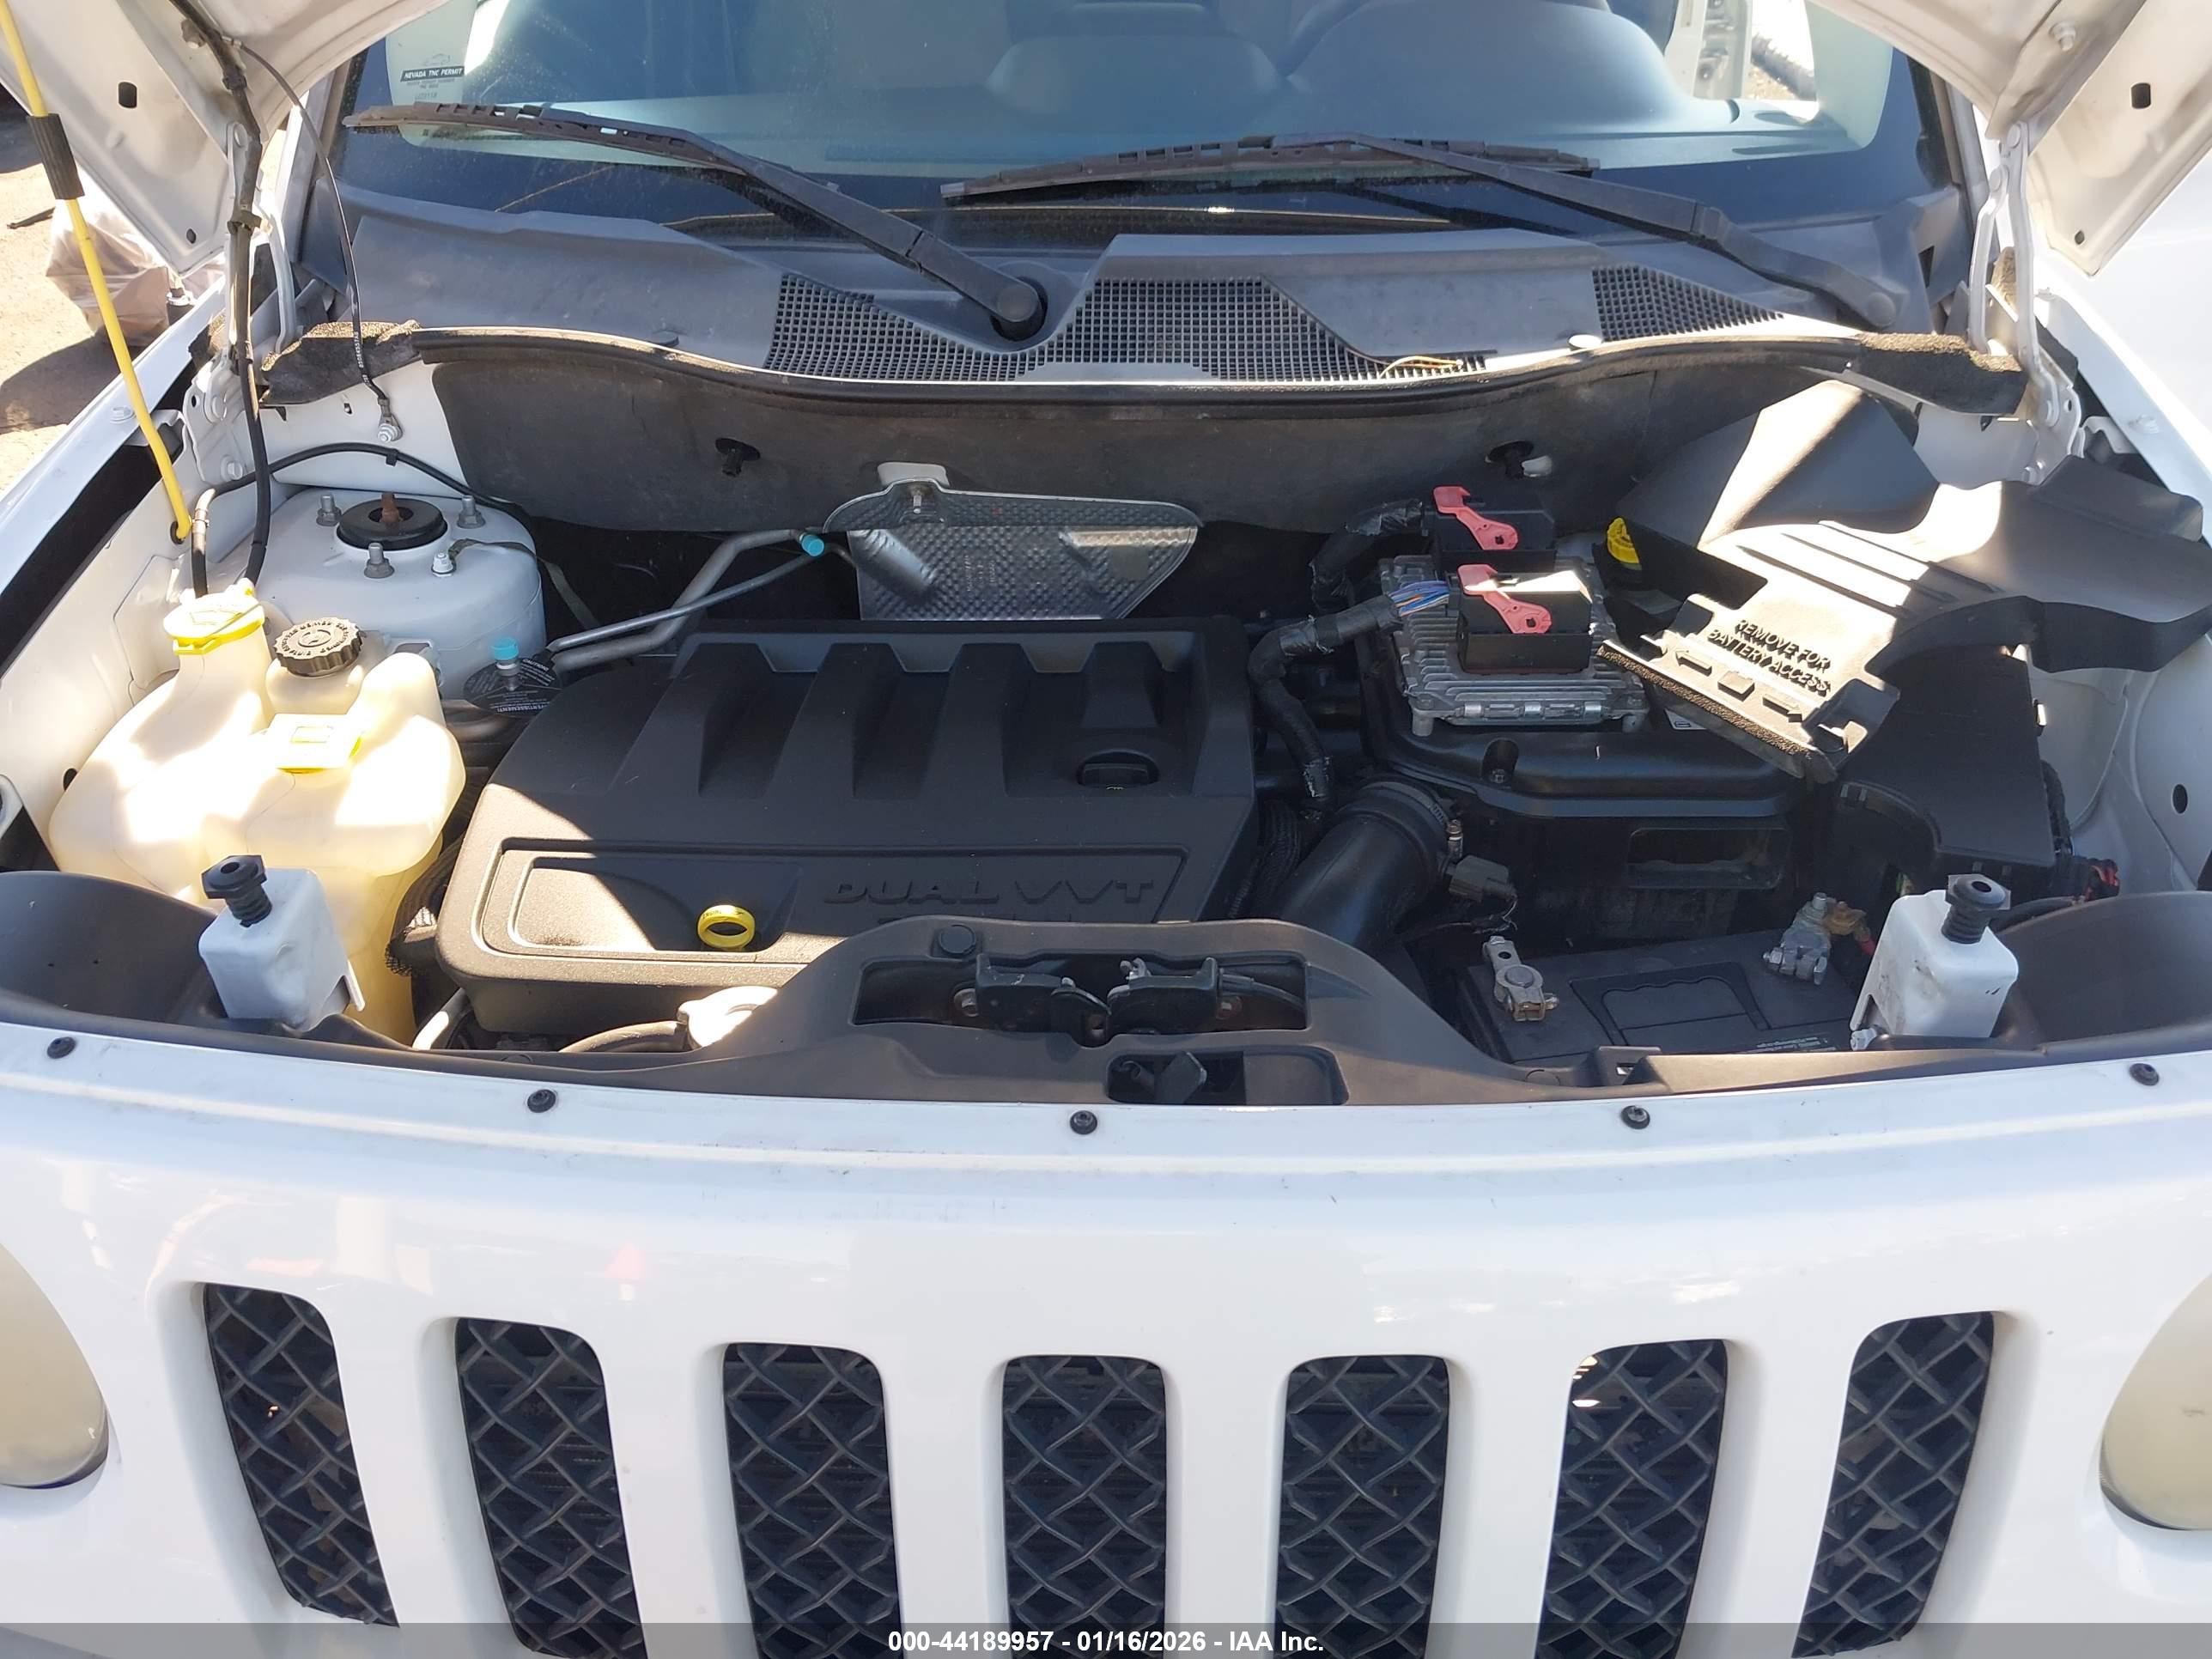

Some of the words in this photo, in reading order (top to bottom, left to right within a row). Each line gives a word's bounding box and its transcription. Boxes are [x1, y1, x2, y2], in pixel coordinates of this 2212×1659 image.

[1707, 629, 1773, 668] BATTERY
[1768, 660, 1832, 697] ACCESS
[1735, 619, 1800, 660] REMOVE
[1797, 649, 1832, 674] FOR
[823, 879, 1000, 905] DUAL
[1014, 879, 1154, 905] VVT
